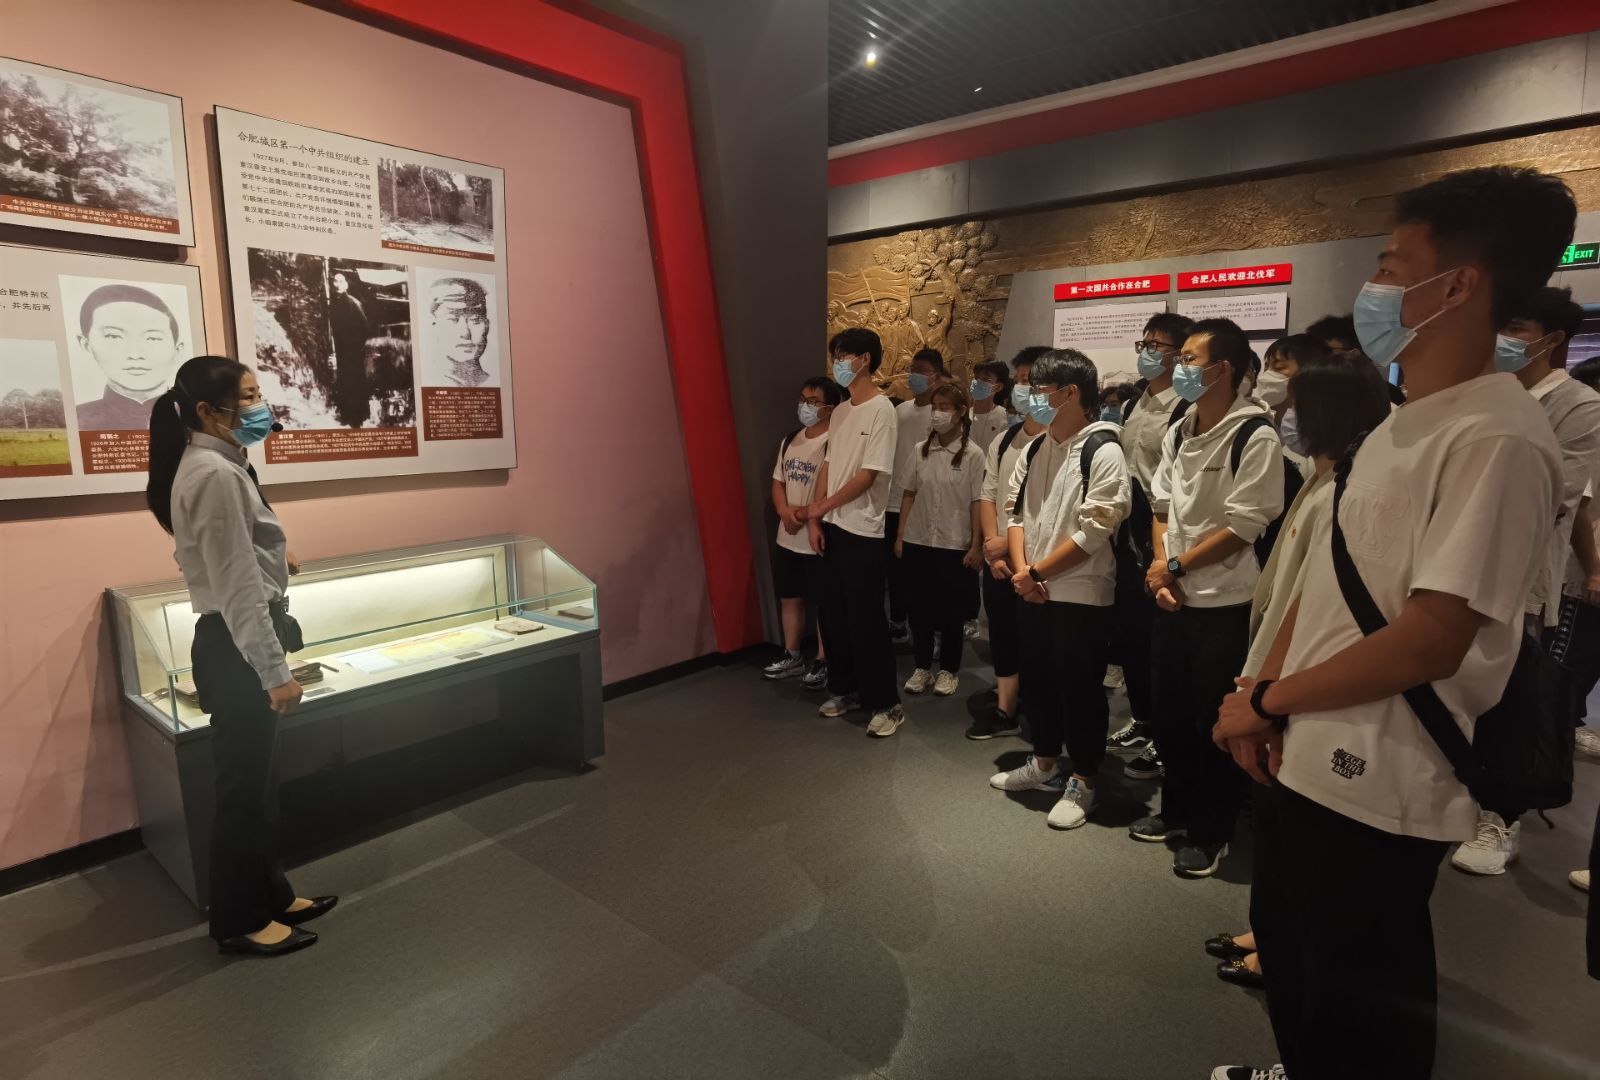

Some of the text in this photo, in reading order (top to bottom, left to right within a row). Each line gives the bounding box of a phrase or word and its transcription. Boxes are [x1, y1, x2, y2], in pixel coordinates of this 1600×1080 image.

[237, 131, 370, 166] 合肥城区第一个中共组织的建立
[1575, 250, 1594, 259] EXIT
[1191, 269, 1276, 284] 合肥人民欢迎北伐军
[1071, 280, 1151, 294] 第一次国共合作在合肥
[1333, 764, 1351, 777] BOX
[1343, 761, 1362, 775] THE
